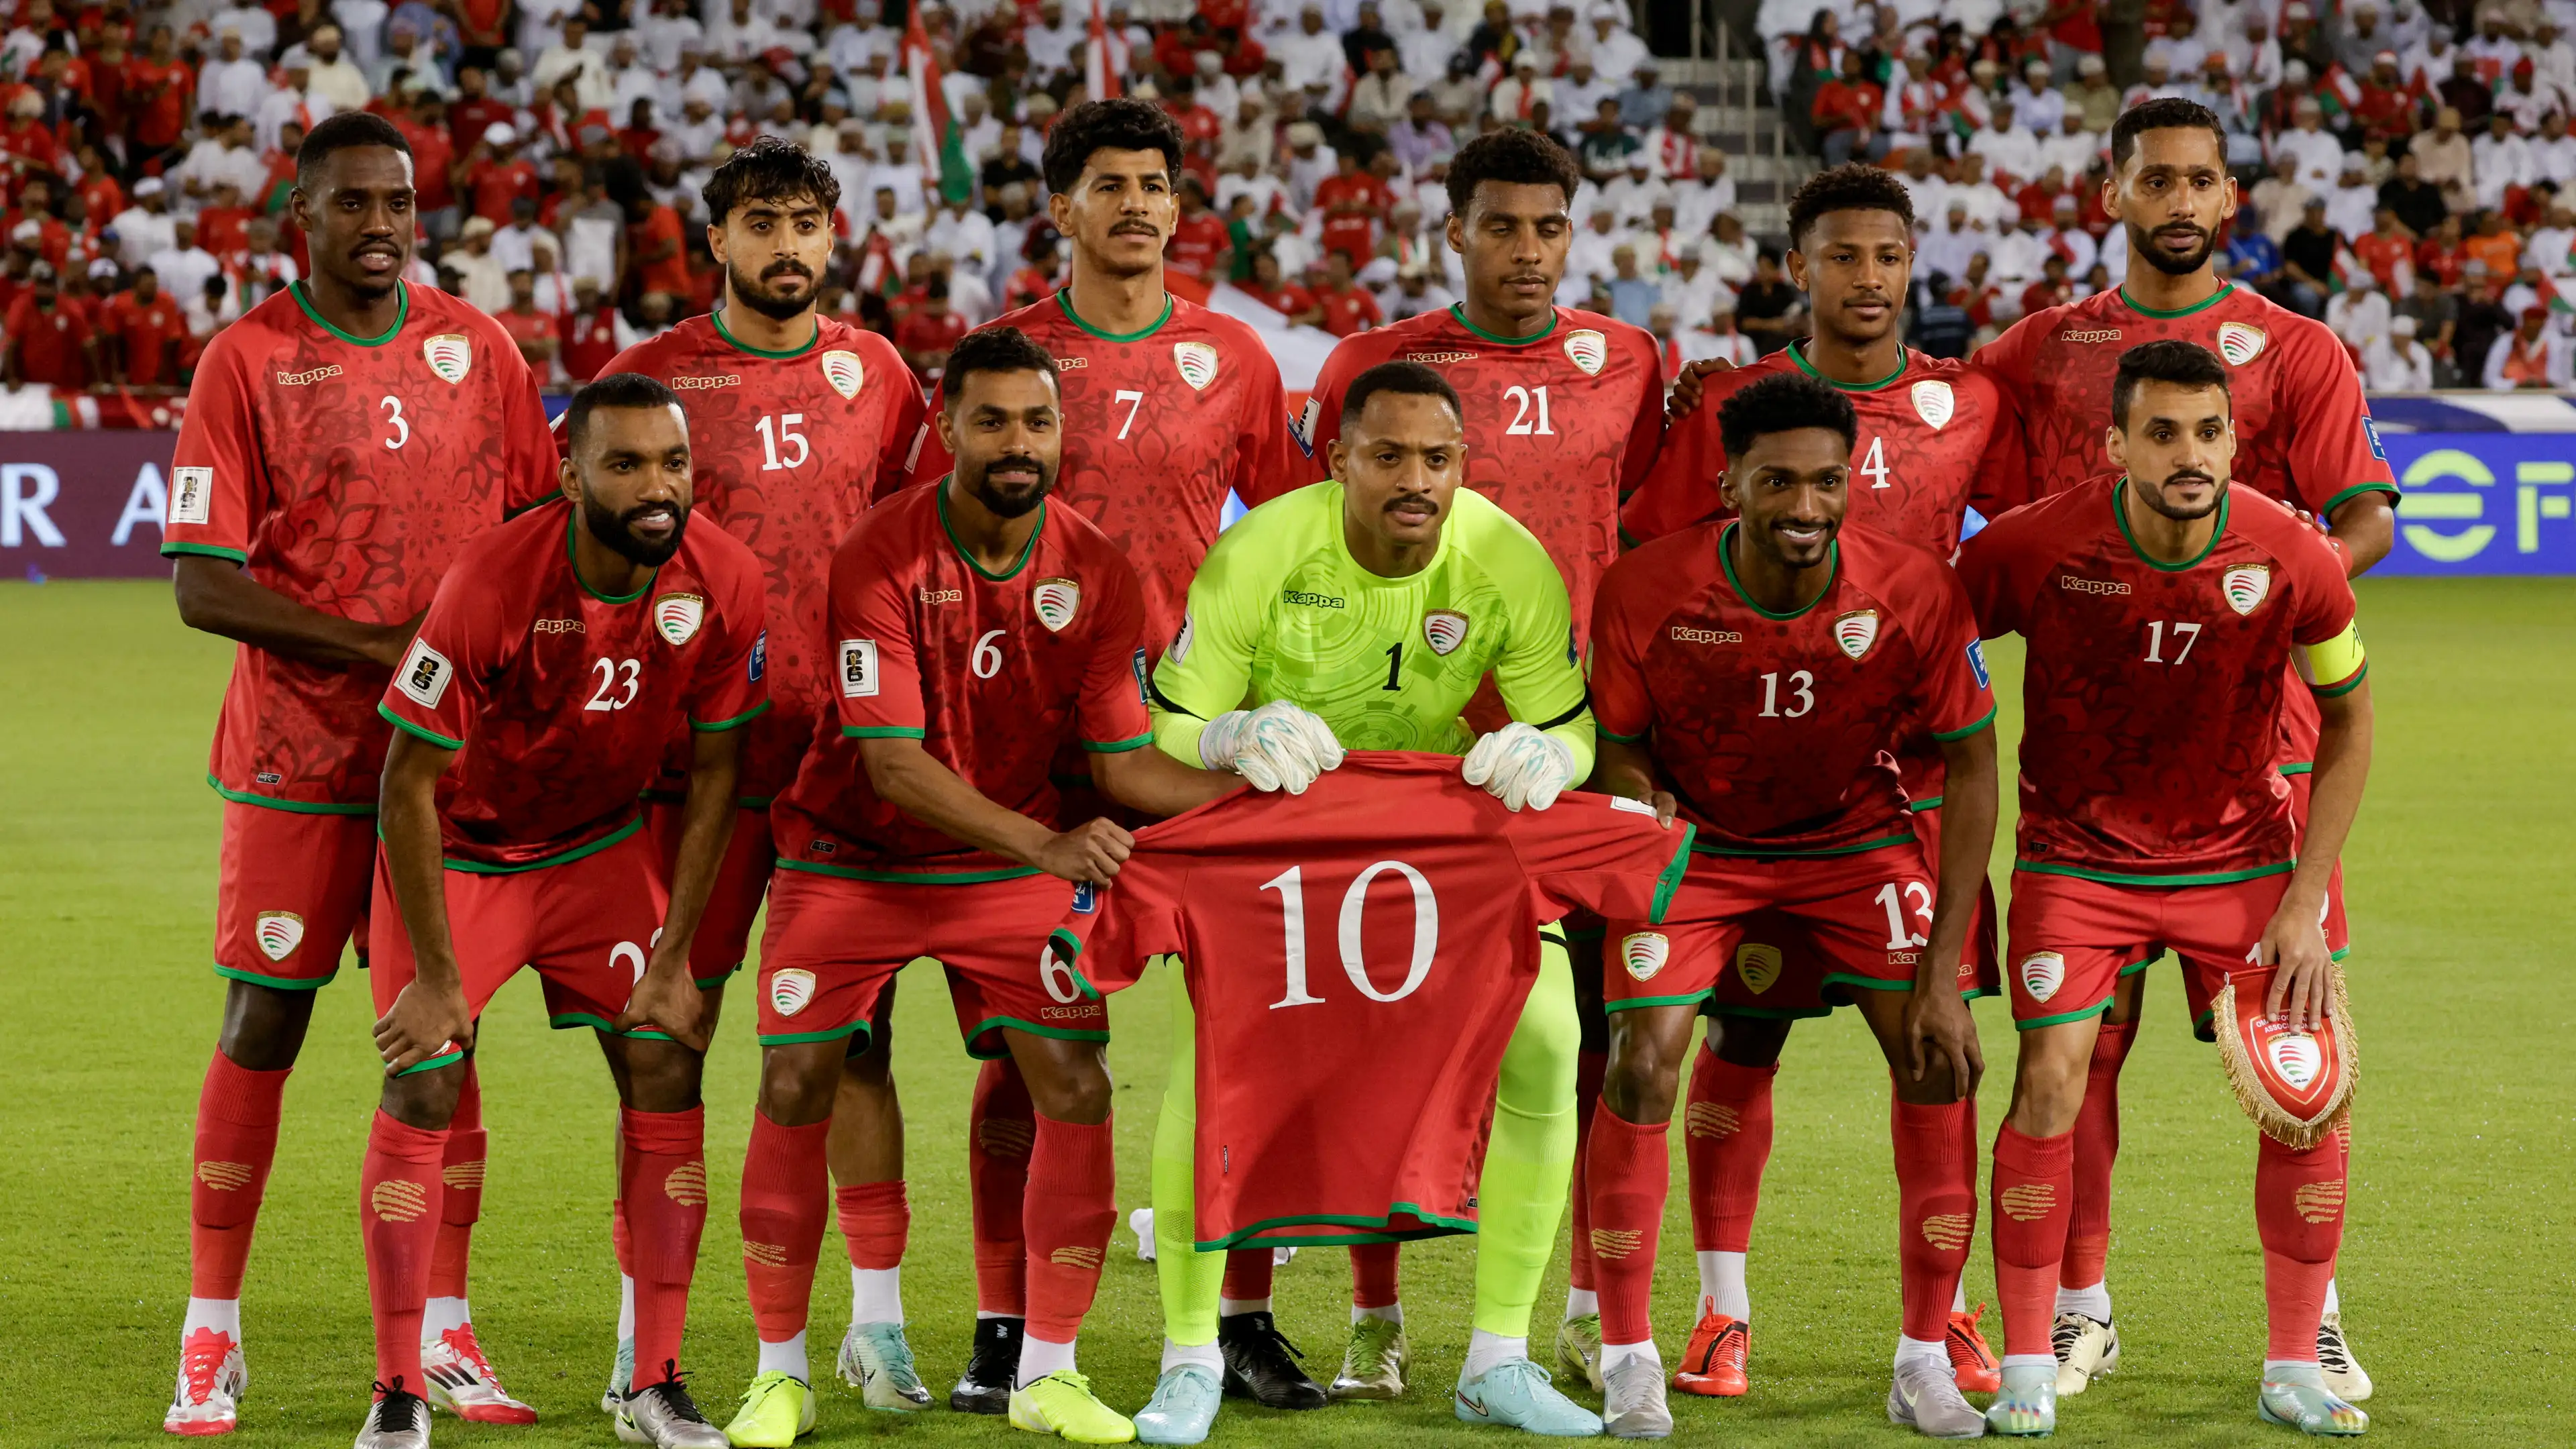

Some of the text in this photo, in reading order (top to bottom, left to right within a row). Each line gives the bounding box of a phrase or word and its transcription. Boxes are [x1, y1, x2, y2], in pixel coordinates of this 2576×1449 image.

[1407, 352, 1478, 363] Kappa
[2061, 329, 2122, 343] Kappa
[277, 364, 343, 385] Kappa
[672, 374, 741, 390] Kappa
[380, 395, 409, 449] 3
[1114, 389, 1144, 440] 7
[1503, 385, 1555, 435] 21
[755, 413, 810, 471] 15
[1860, 436, 1891, 489] 4
[1283, 590, 1345, 608] Kappa
[2062, 576, 2131, 595] Kappa
[534, 619, 586, 633] appa
[1672, 627, 1742, 644] Kappa
[2143, 621, 2202, 665] 17
[972, 629, 1006, 679] 6
[1382, 642, 1403, 692] 1
[584, 657, 641, 711] 23
[1758, 671, 1814, 718] 13
[1259, 860, 1438, 1010] 10
[1875, 881, 1935, 950] 13
[609, 927, 663, 1014] 2
[1040, 944, 1081, 1004] 6
[1041, 1006, 1101, 1019] Kappa
